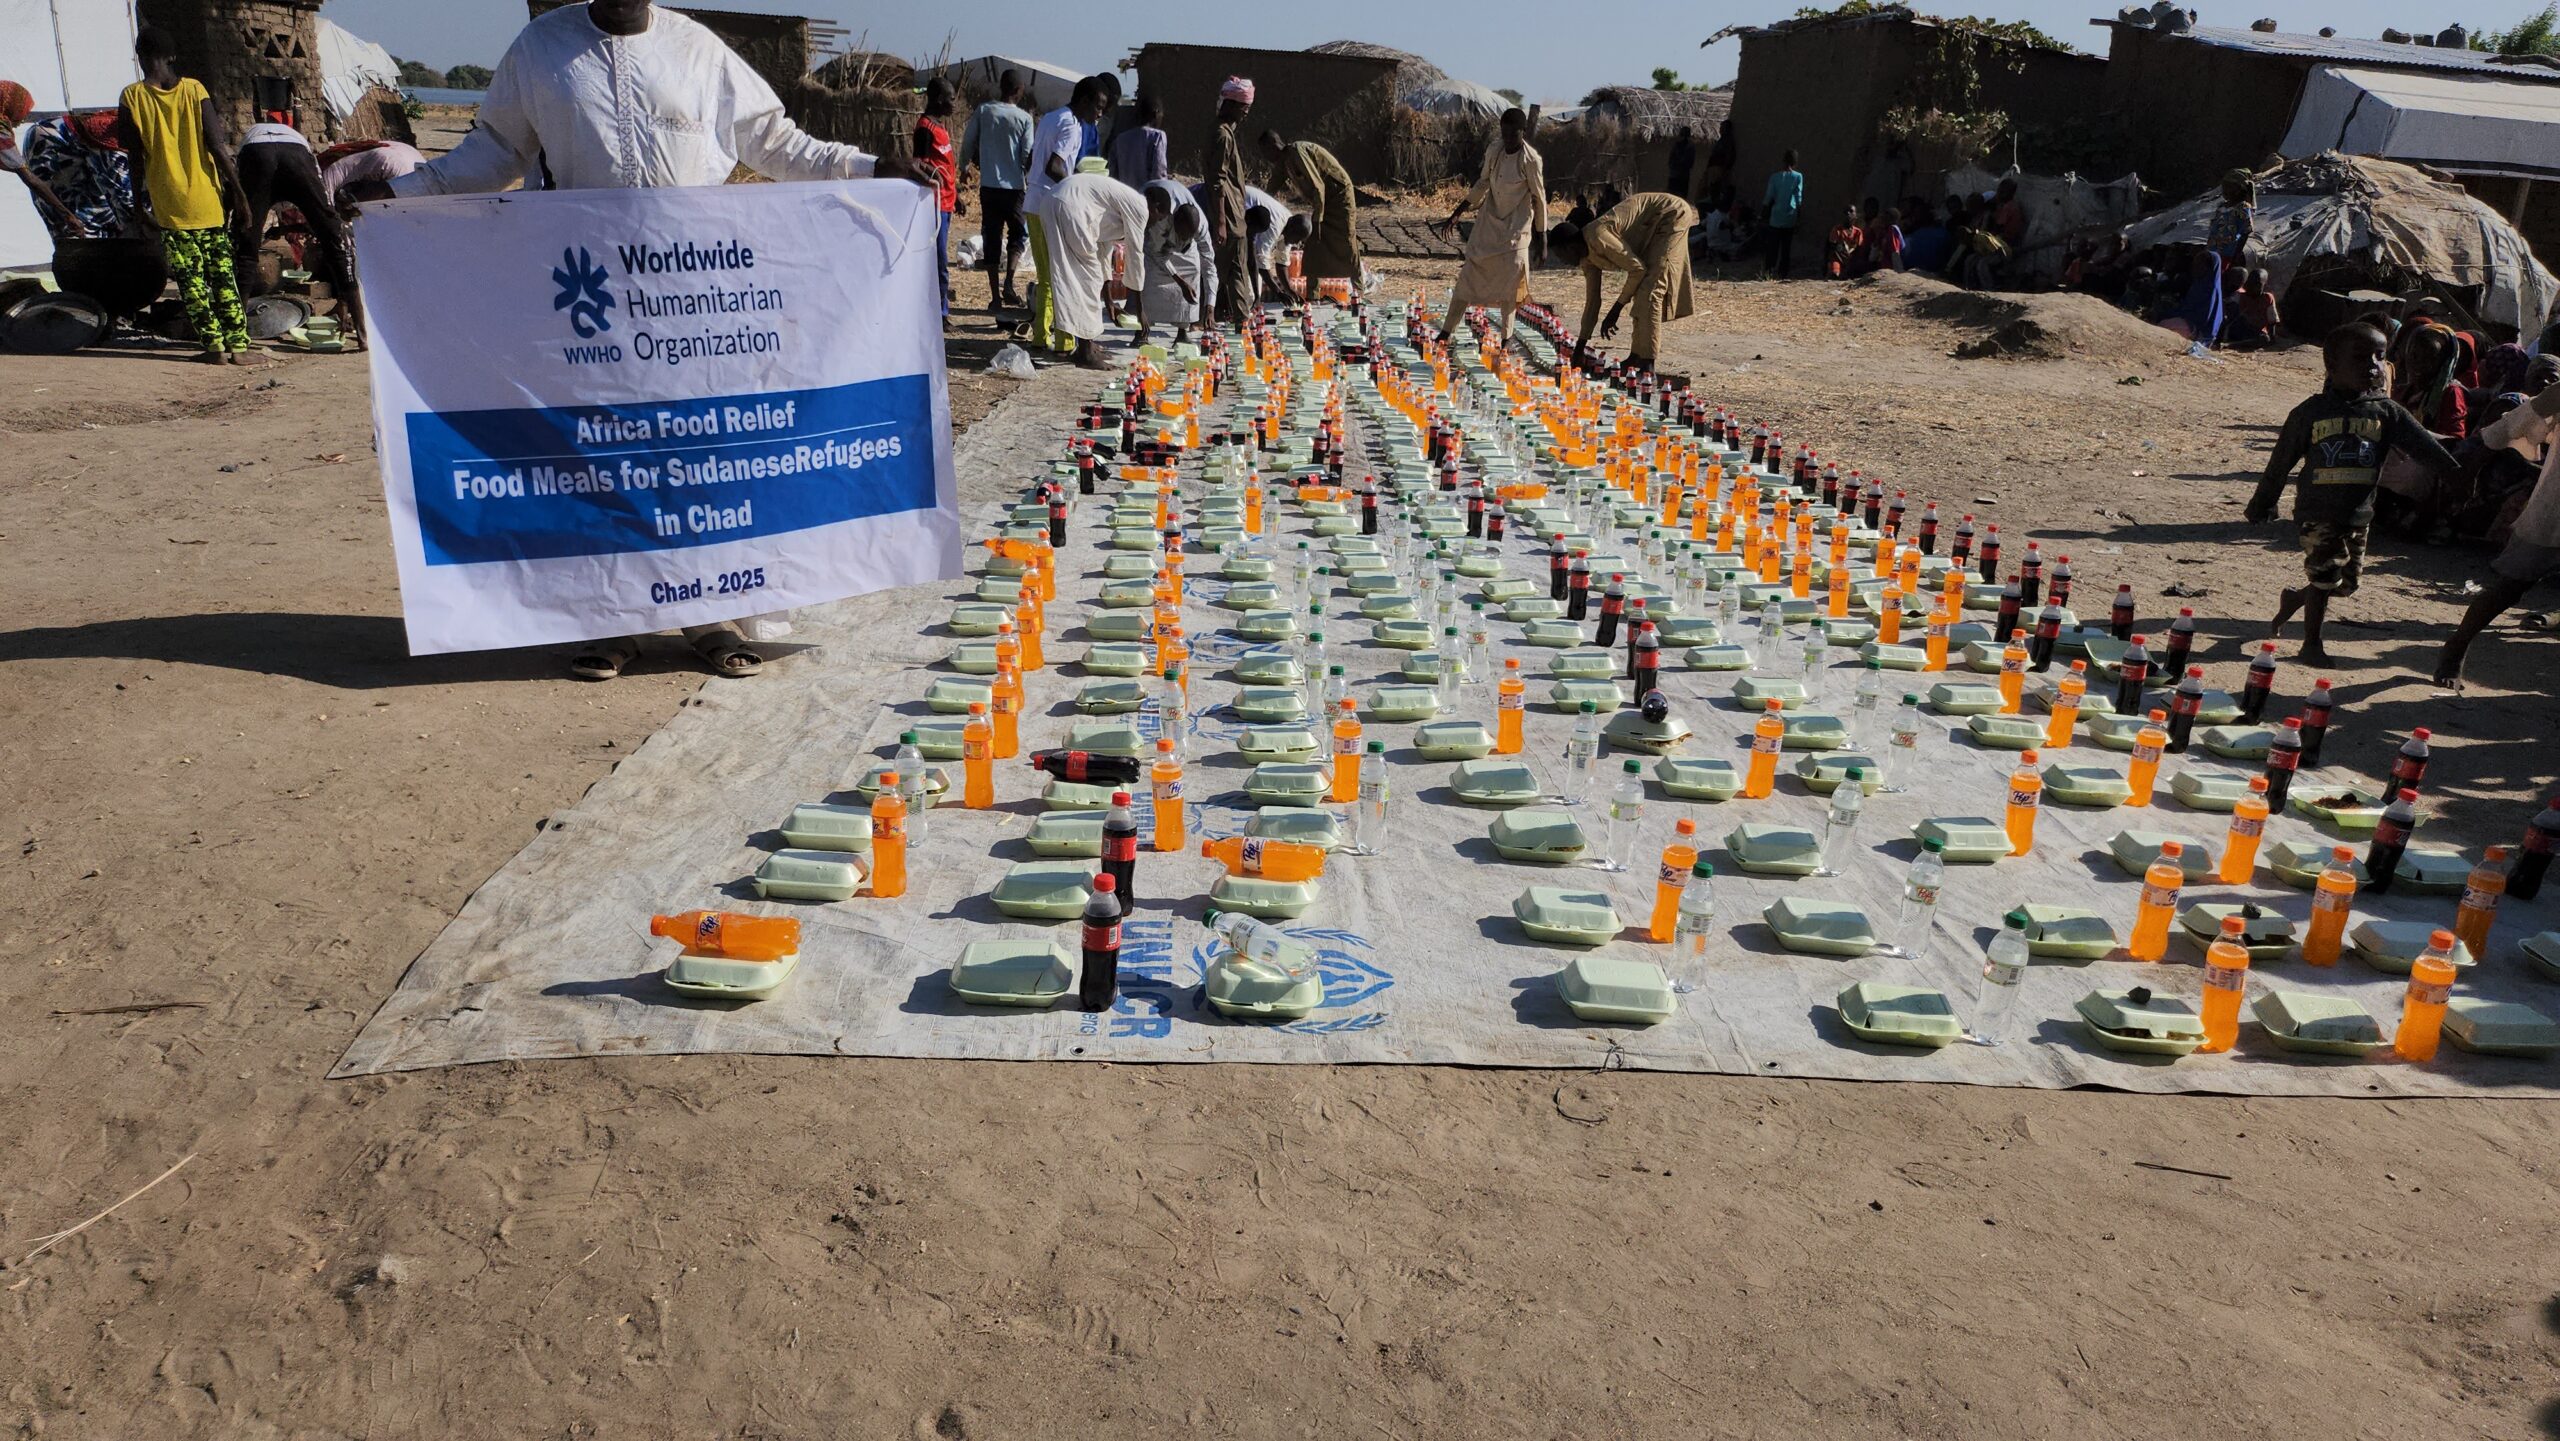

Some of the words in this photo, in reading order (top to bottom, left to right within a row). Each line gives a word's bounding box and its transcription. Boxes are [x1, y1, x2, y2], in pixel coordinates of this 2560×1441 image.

[617, 240, 754, 275] Worldwide
[626, 284, 783, 319] Humanitarian
[563, 344, 622, 365] WWHO
[633, 327, 780, 366] Organization
[576, 414, 652, 444] Africa
[658, 408, 717, 438] Food
[725, 400, 796, 431] Relief
[454, 466, 526, 500] Food
[531, 462, 615, 497] Meals
[619, 457, 661, 489] for
[667, 435, 902, 484] SudaneseRefugees
[654, 507, 681, 538] in
[686, 499, 754, 534] Chad
[651, 579, 702, 604] Chad
[717, 567, 766, 596] 2025
[1109, 921, 1173, 1038] UNHCR
